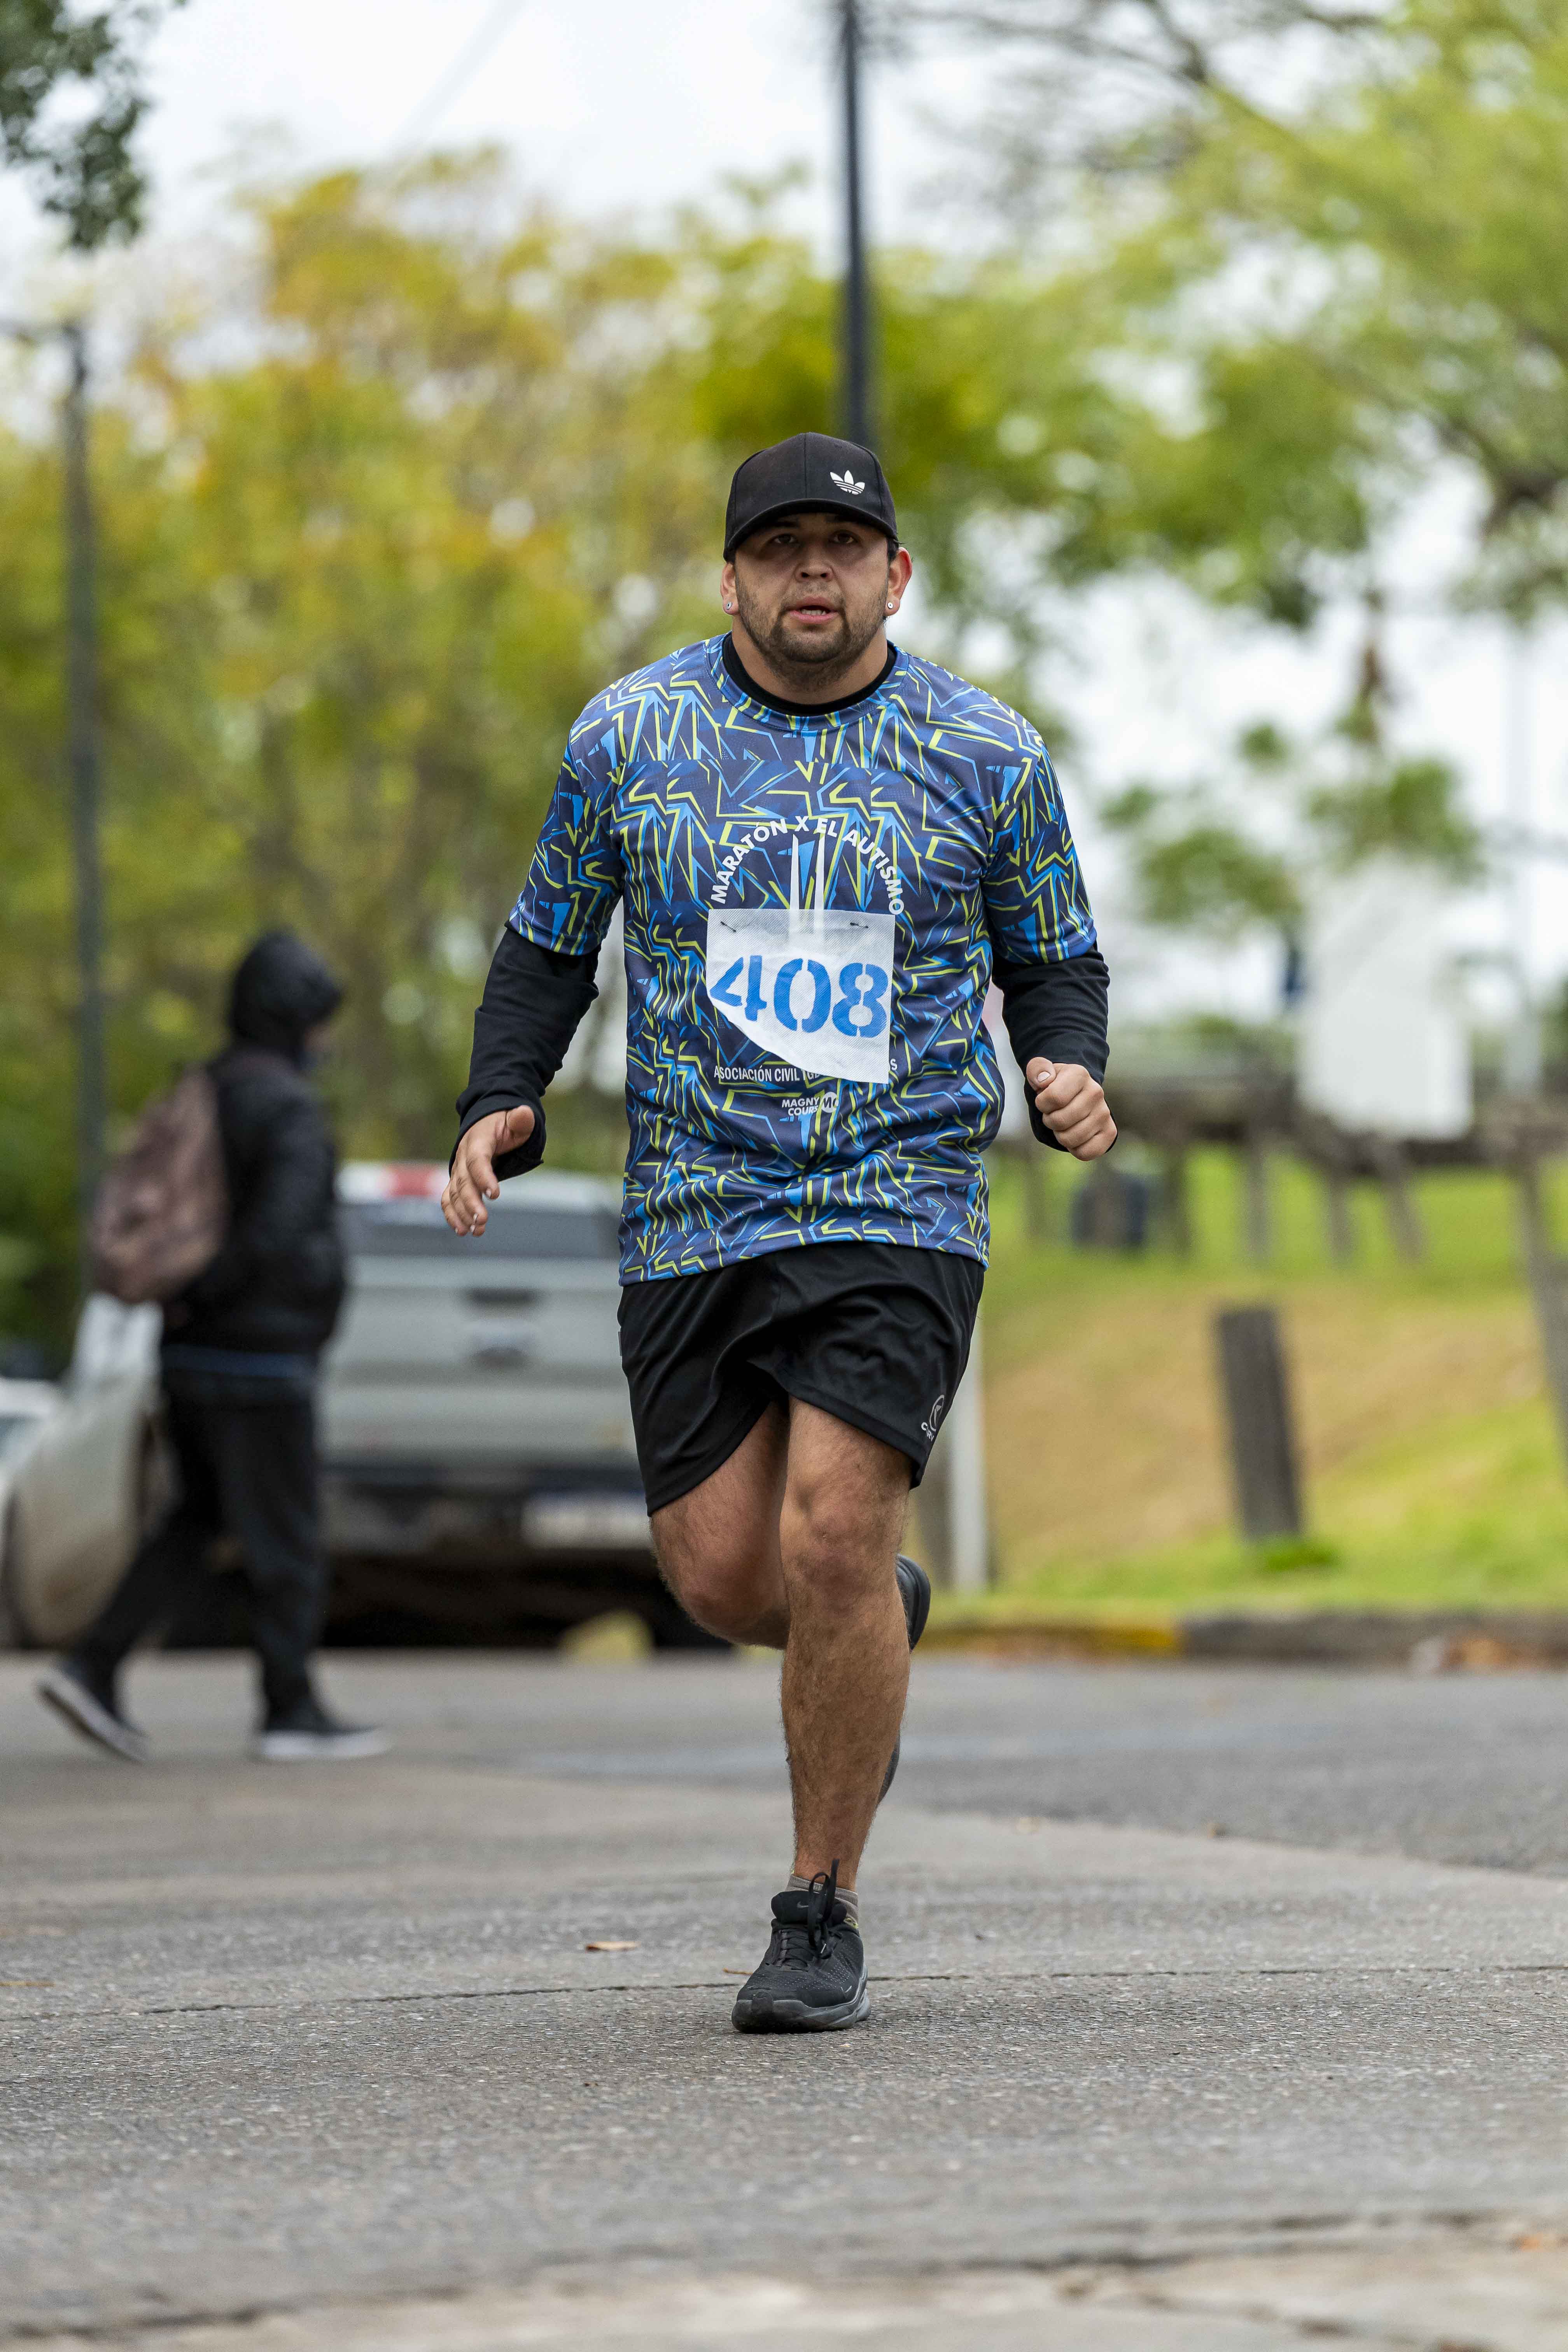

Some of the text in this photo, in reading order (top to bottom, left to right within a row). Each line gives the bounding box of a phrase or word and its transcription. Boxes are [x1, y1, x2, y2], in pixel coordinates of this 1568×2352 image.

[710, 816, 905, 915] MARATÓN X EL AUTISMO
[709, 955, 888, 1038] 408
[714, 1066, 772, 1082] ASOCIACIÓN
[774, 1068, 800, 1082] CIVIL
[782, 1097, 820, 1108] MAGNY
[788, 1106, 819, 1116] COURS
